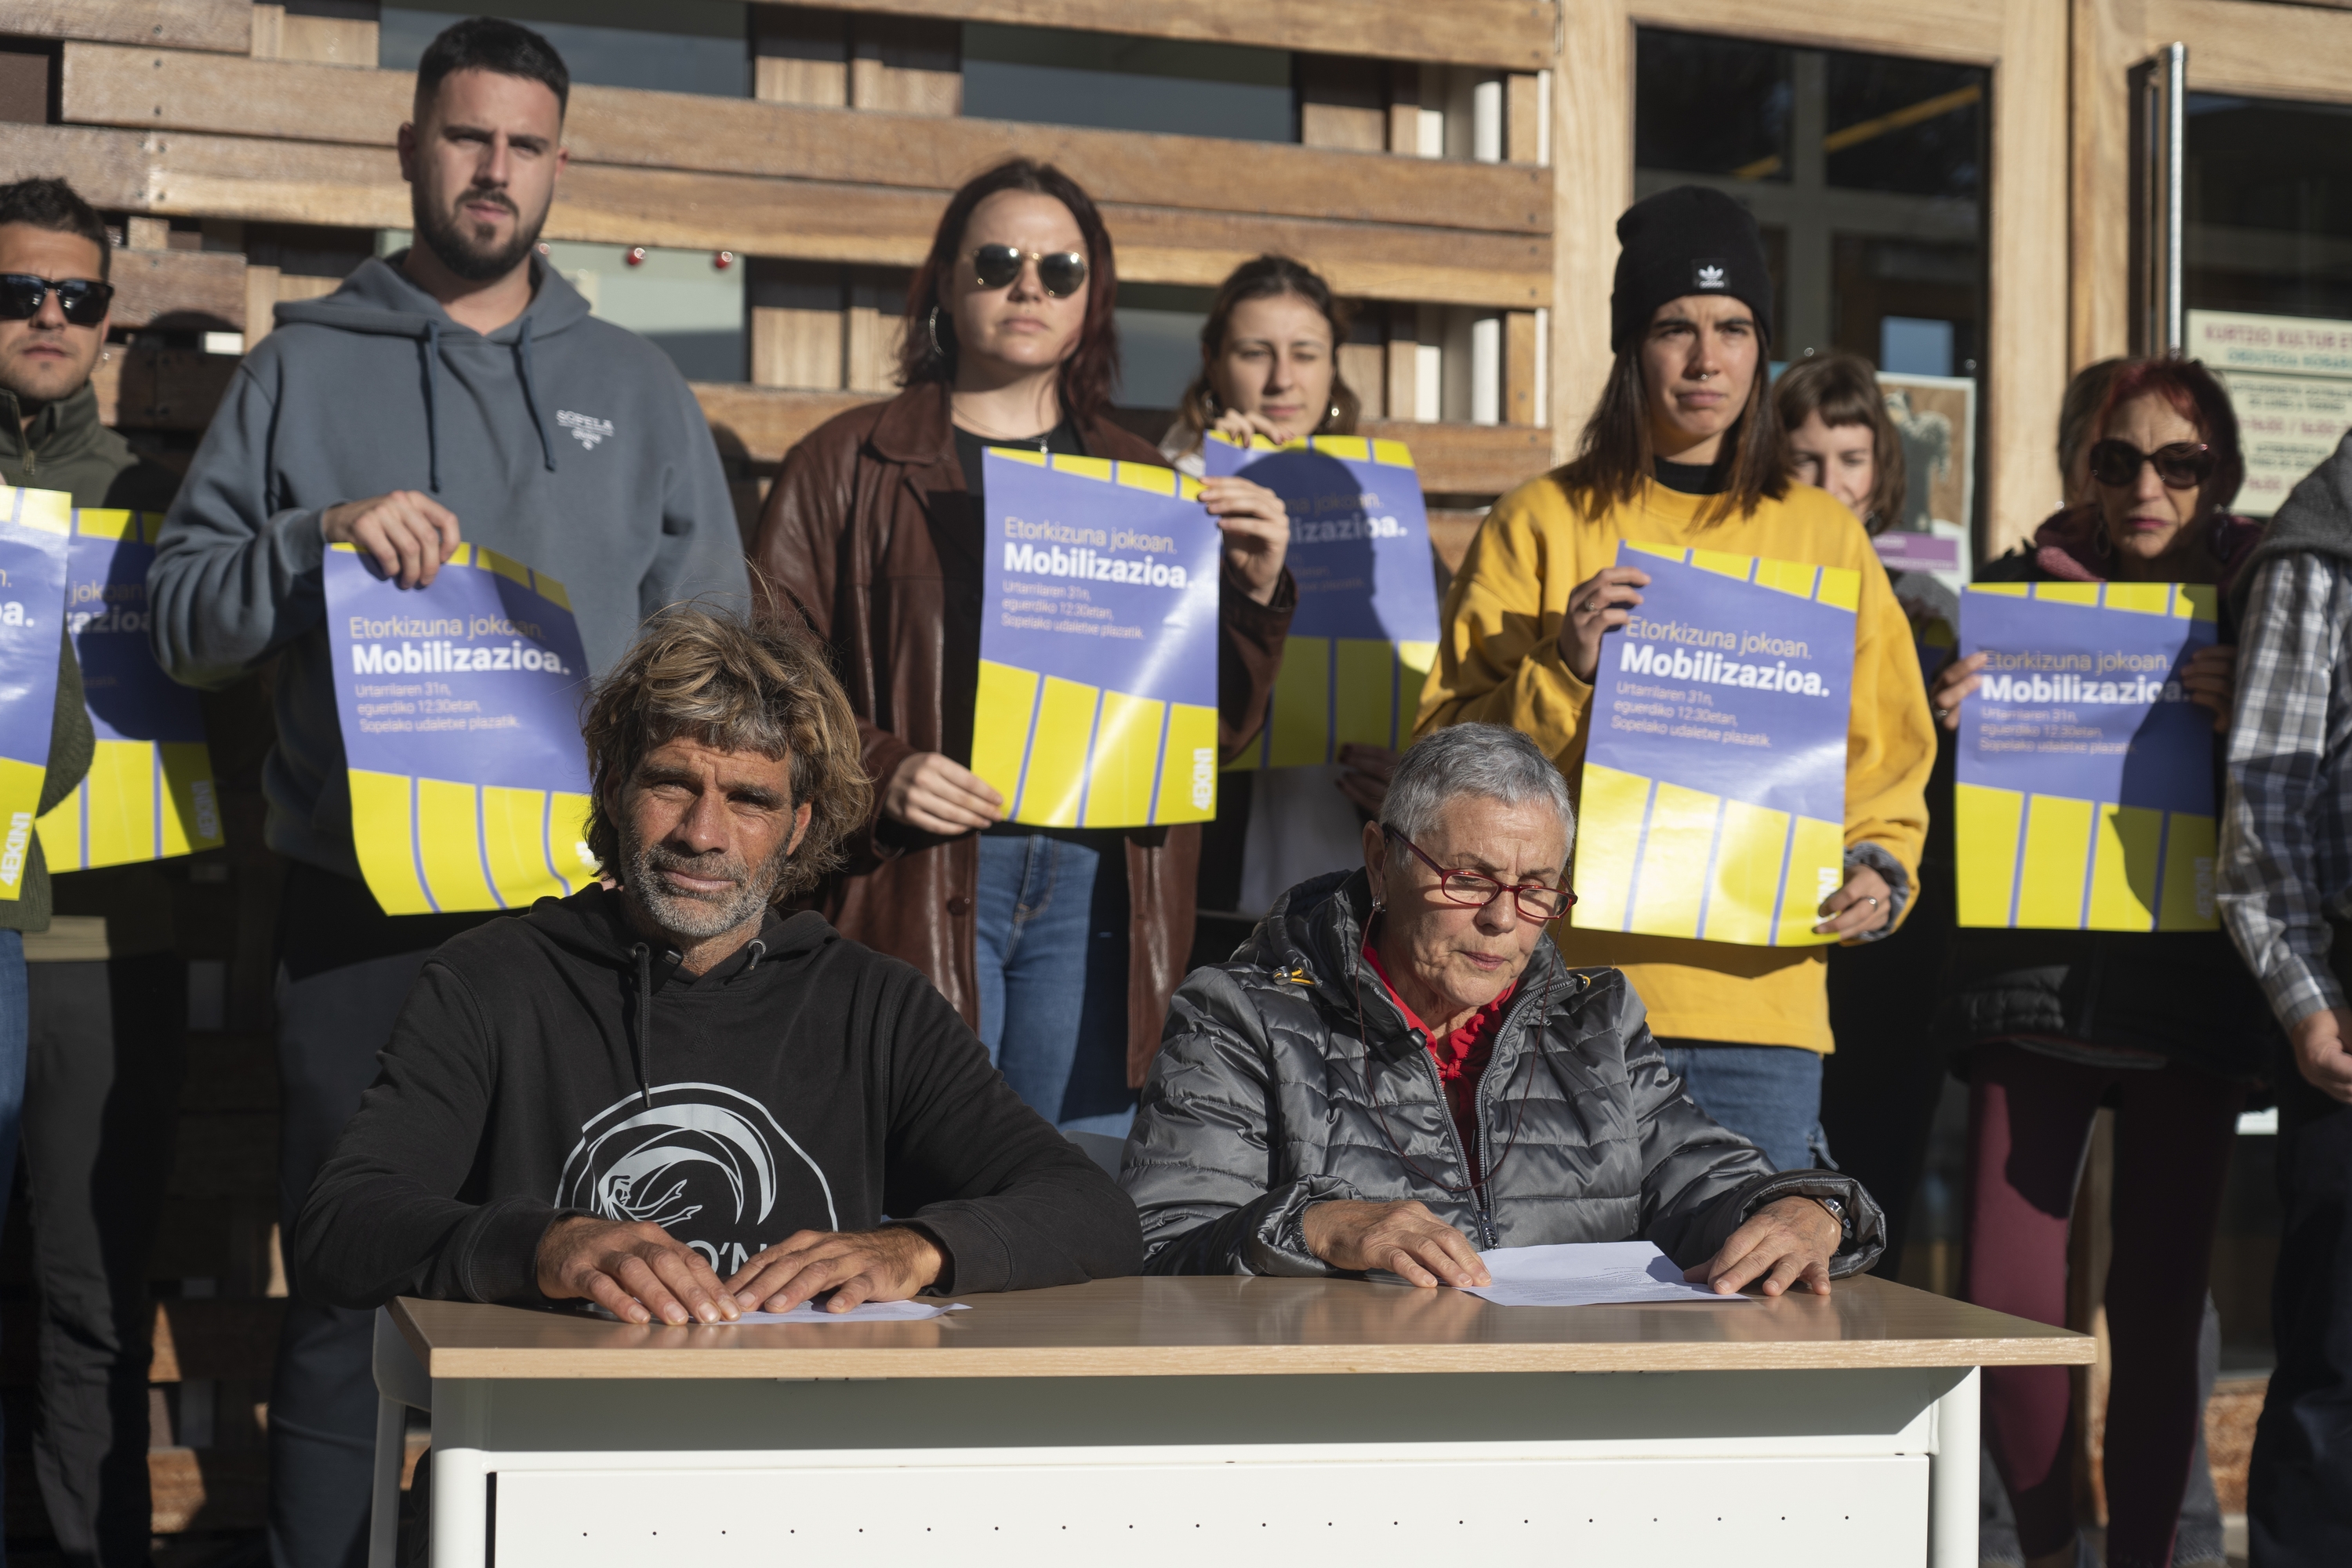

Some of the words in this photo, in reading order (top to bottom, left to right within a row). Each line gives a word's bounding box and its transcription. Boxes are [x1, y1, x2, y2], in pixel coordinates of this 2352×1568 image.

[1004, 516, 1106, 546] Etorkizuna
[1109, 527, 1178, 554] jokoan.
[1004, 541, 1195, 590] Mobilizazioa.
[1003, 579, 1066, 598] Urtarrilaren
[1001, 597, 1058, 614] eguerdiko
[350, 614, 463, 639] Etorkizuna
[467, 614, 546, 641] jokoan.
[1000, 612, 1052, 630] Sopelako
[1625, 615, 1737, 650] Etorkizuna
[1738, 630, 1812, 659] jokoan.
[352, 640, 572, 676] Mobilizazioa.
[1620, 641, 1830, 697] Mobilizazioa.
[1983, 650, 2092, 672] Etorkizuna
[2095, 650, 2172, 677] jokoan.
[355, 682, 422, 698] Urtarrilaren
[1616, 681, 1685, 703] Urtarrilaren
[1980, 673, 2190, 705] Mobilizazioa.
[358, 702, 415, 718] eguerdiko
[1613, 699, 1675, 719] eguerdiko
[359, 717, 412, 734] Sopelako
[1610, 715, 1668, 735] Sopelako
